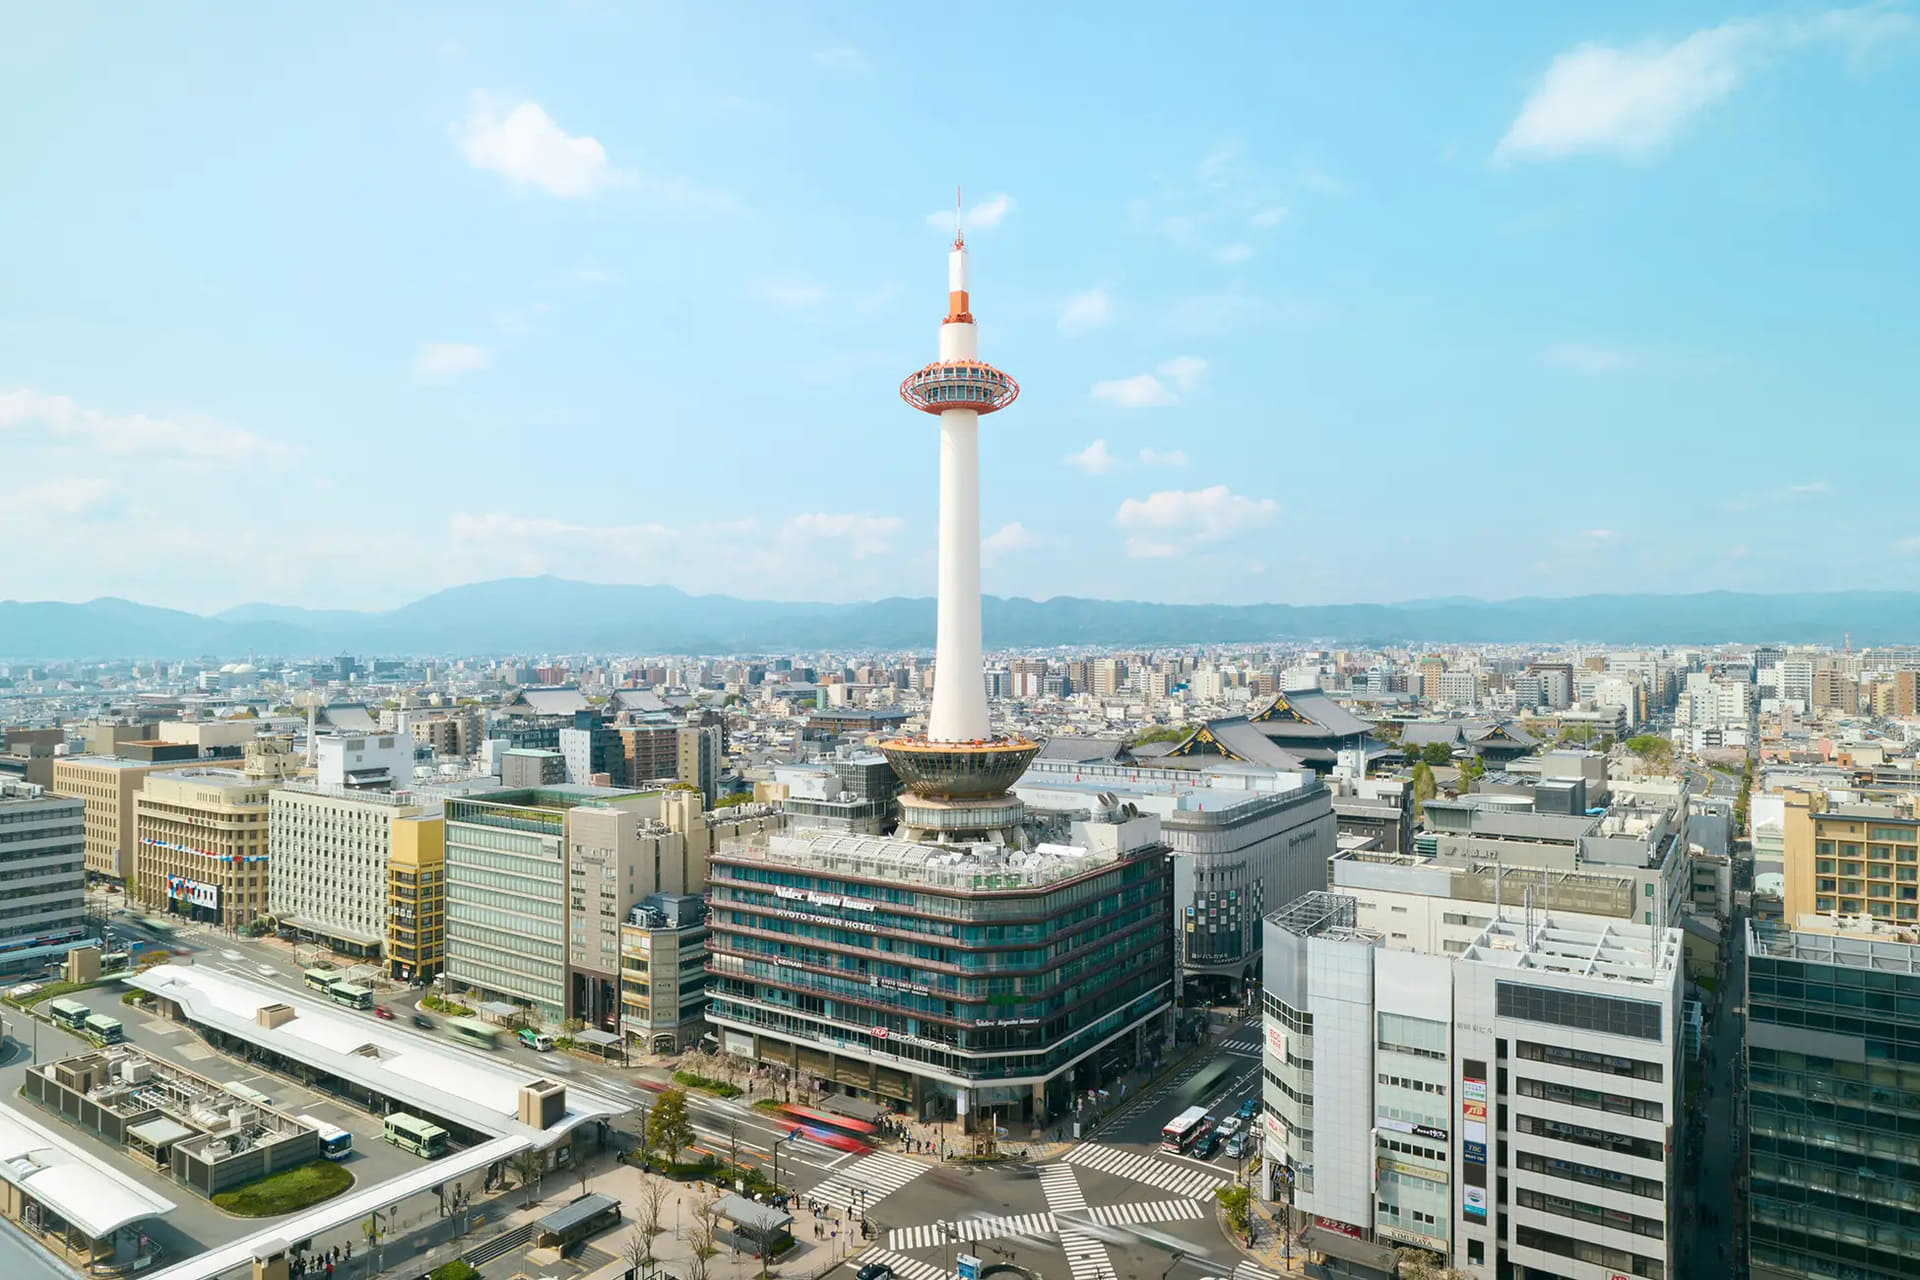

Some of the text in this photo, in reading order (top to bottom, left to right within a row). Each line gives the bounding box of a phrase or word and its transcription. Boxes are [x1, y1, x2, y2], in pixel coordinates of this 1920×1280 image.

[774, 886, 877, 912] Nidec Kyoto Tower
[777, 909, 877, 932] KYOTO TOWER HOTEL
[1467, 1105, 1484, 1115] JTB
[1322, 1217, 1353, 1232] カラオケ
[1391, 1231, 1433, 1248] KIMURAYA
